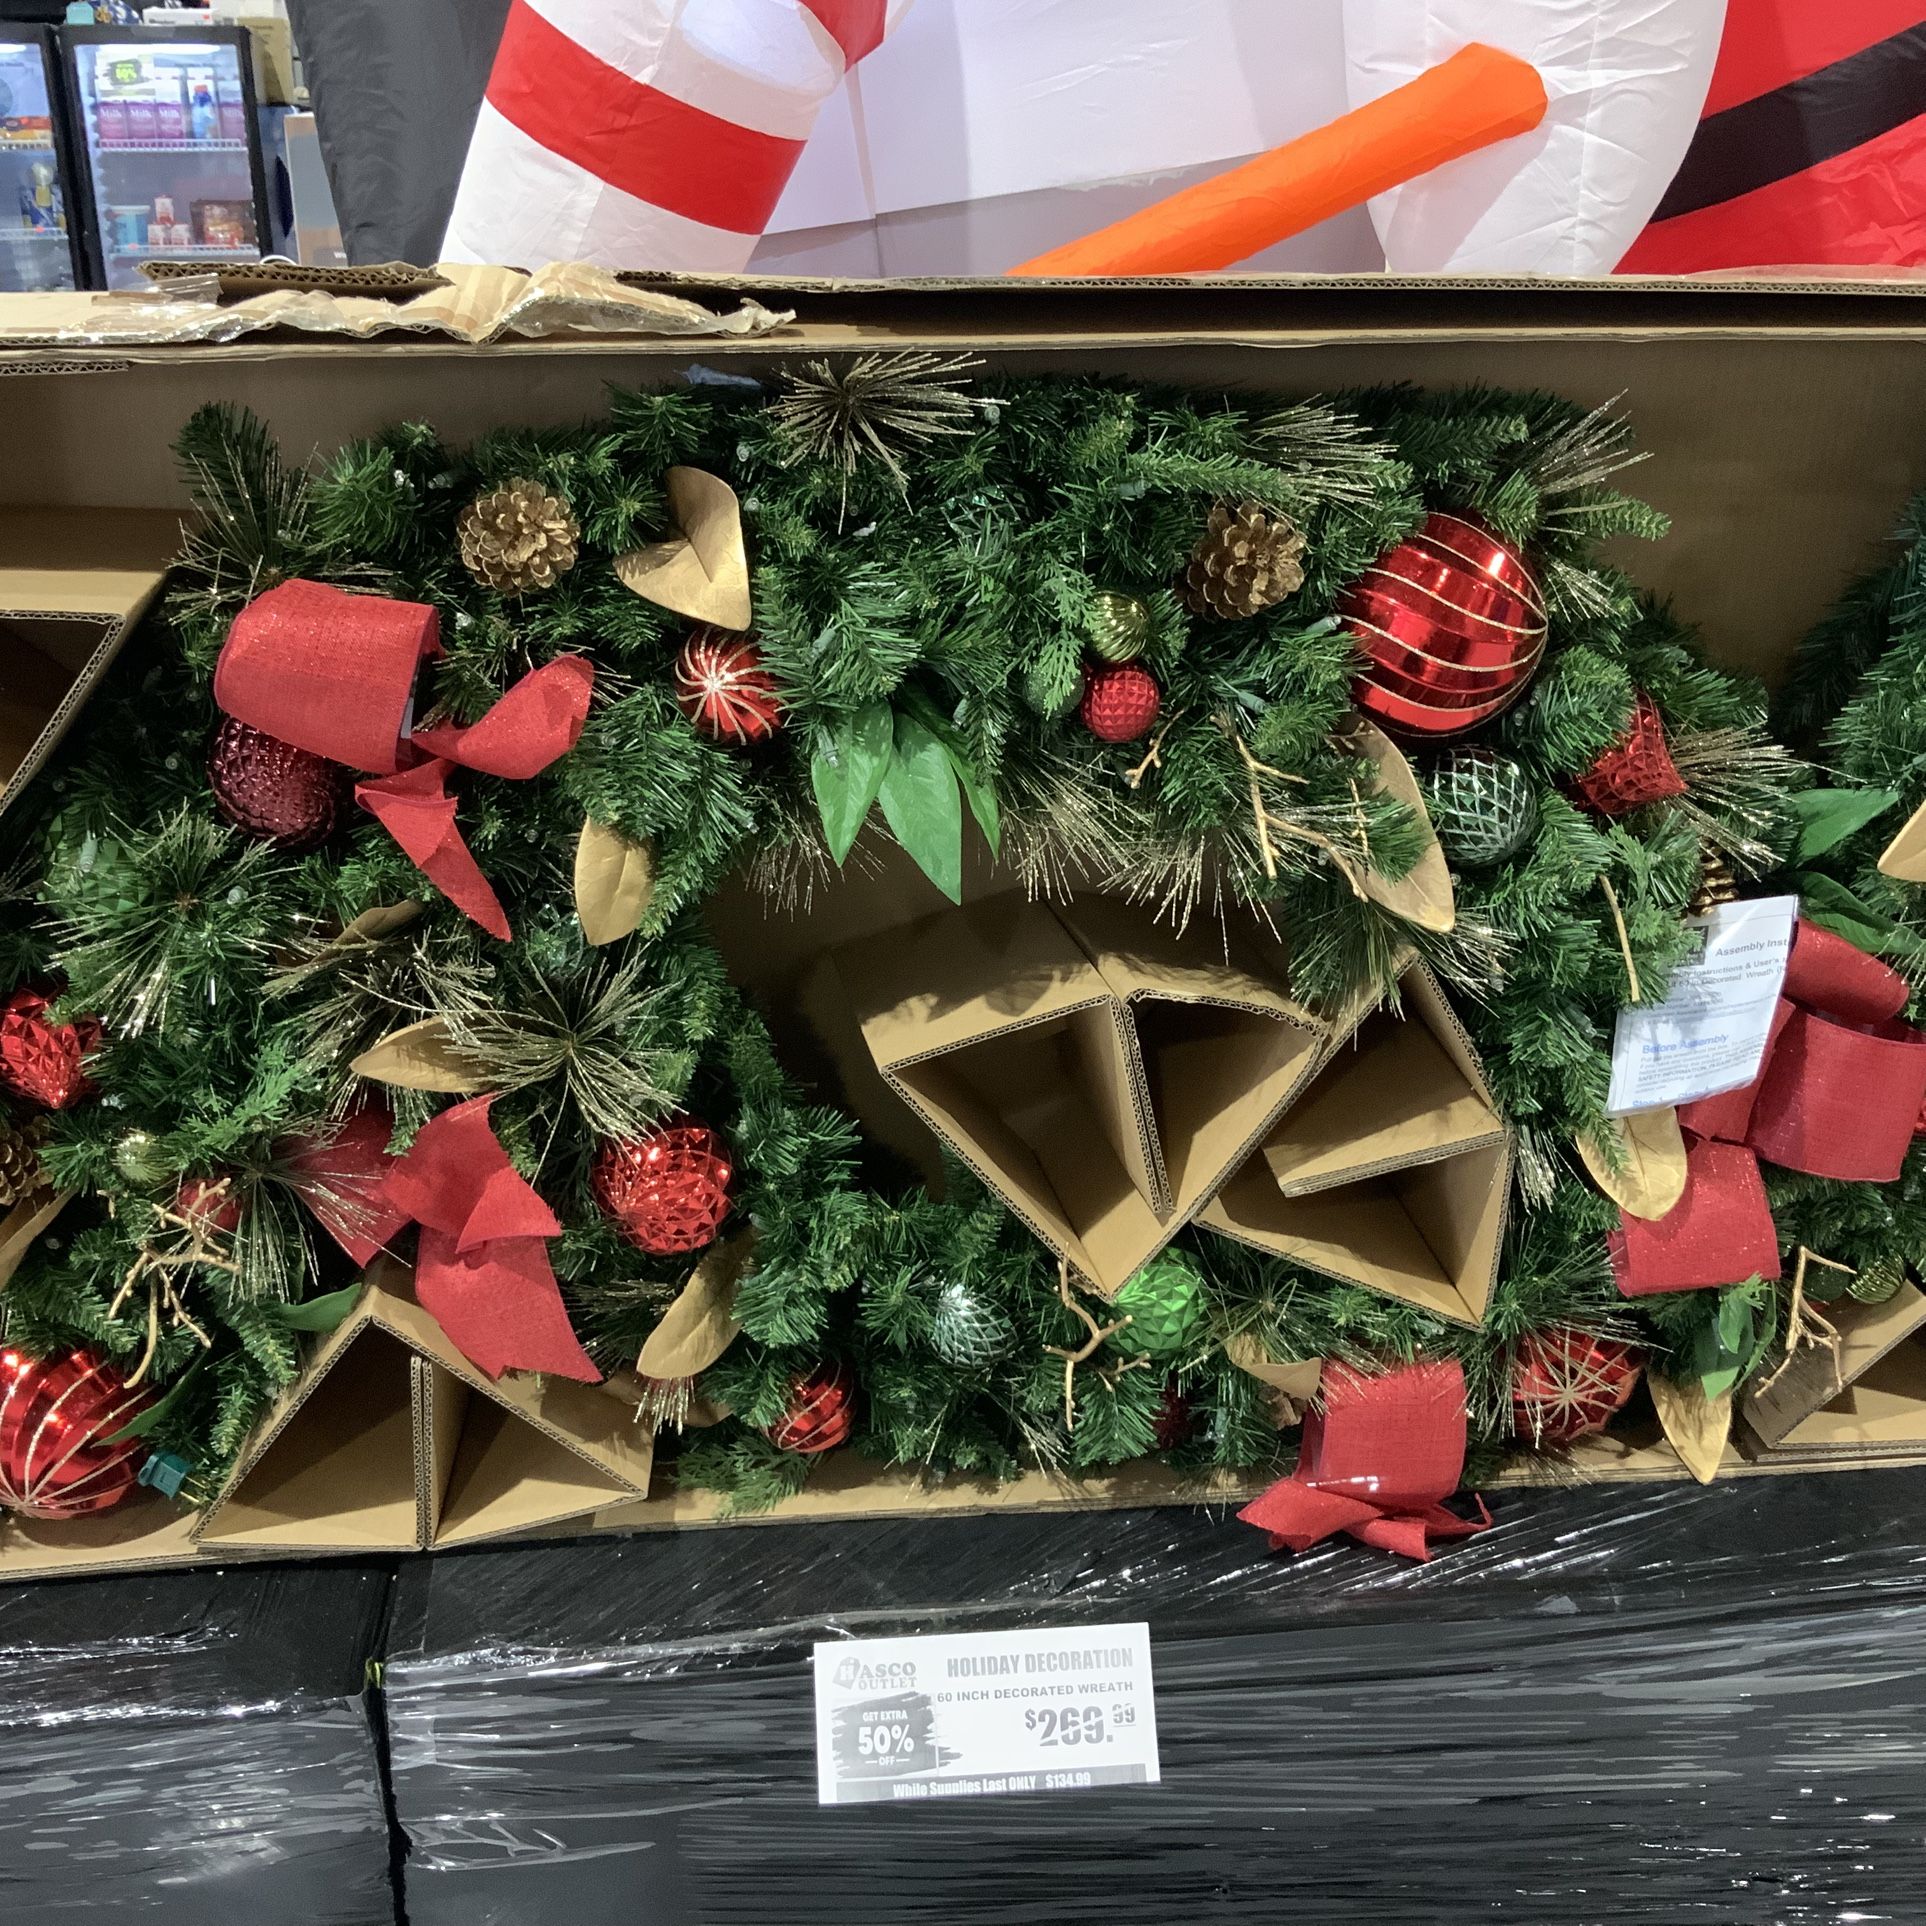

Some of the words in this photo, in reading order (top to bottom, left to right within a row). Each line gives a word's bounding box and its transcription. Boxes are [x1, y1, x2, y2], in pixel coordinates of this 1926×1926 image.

[1715, 941, 1765, 957] Assembly
[1642, 1043, 1677, 1054] Before
[1680, 1034, 1729, 1049] Assembly
[947, 1654, 1020, 1678] HOLIDAY
[1024, 1647, 1133, 1673] DECORATION
[858, 1677, 918, 1690] OUTLET
[937, 1691, 953, 1702] 60
[957, 1690, 989, 1701] INCH
[994, 1685, 1074, 1700] DECORATED
[1077, 1681, 1133, 1694] WREATH
[863, 1712, 878, 1722] GET
[880, 1710, 908, 1721] EXTRA
[858, 1724, 915, 1755] 50%
[878, 1756, 895, 1766] OFF
[893, 1782, 928, 1798] While
[982, 1778, 1007, 1793] Last
[1009, 1775, 1036, 1791] ONLY
[1045, 1772, 1091, 1788] $134.99
